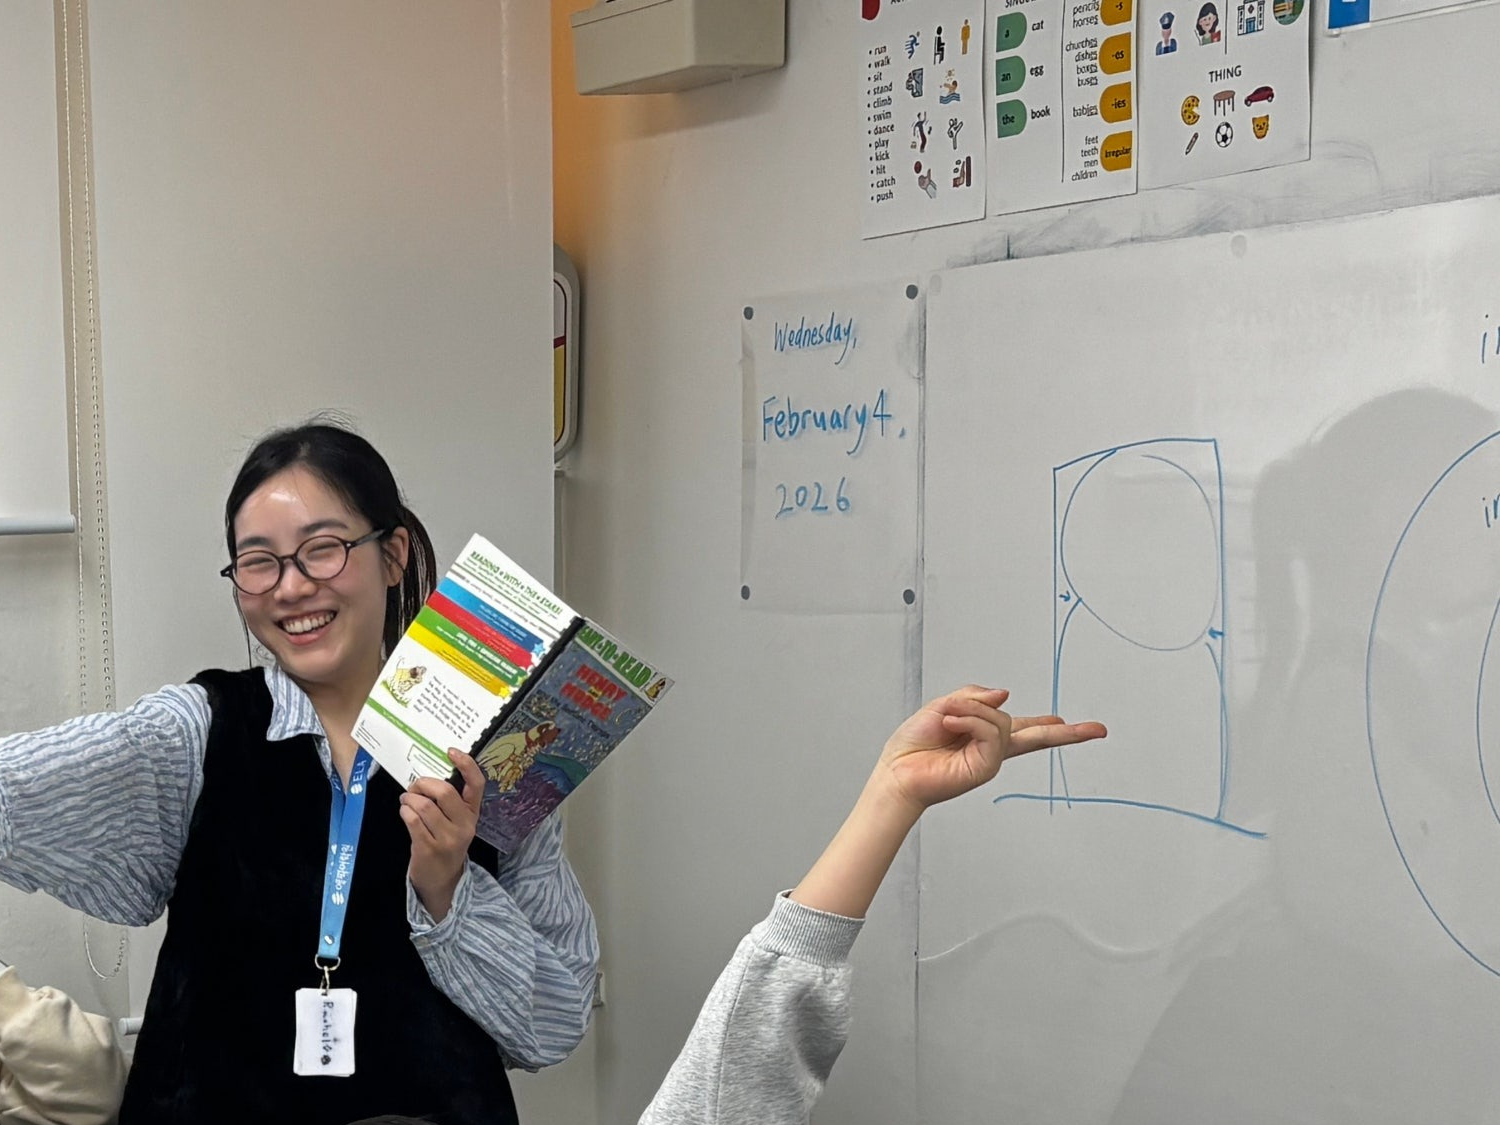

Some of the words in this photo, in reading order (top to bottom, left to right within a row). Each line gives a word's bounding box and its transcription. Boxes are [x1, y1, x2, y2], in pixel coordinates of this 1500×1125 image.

[1073, 1, 1099, 16] pencils
[1032, 20, 1044, 30] cat
[1073, 15, 1098, 27] horses
[1066, 37, 1098, 51] churches
[874, 45, 886, 55] run
[1075, 50, 1098, 61] dishes
[874, 57, 890, 68] walk
[1030, 66, 1043, 77] egg
[1076, 63, 1098, 75] boxes
[1209, 65, 1242, 83] THING
[874, 71, 882, 82] sit
[1077, 77, 1098, 86] buses
[873, 84, 892, 95] stand
[873, 97, 892, 108] climb
[873, 111, 891, 121] swim
[1031, 107, 1050, 119] book
[1073, 104, 1098, 117] babies
[1002, 114, 1015, 124] the
[874, 123, 894, 134] dance
[874, 139, 889, 149] play
[1085, 136, 1098, 145] feet
[875, 150, 889, 161] kick
[1081, 147, 1098, 157] teeth
[1084, 159, 1098, 167] men
[876, 165, 885, 174] hit
[1072, 170, 1097, 181] children
[877, 177, 896, 188] catch
[876, 191, 893, 203] push
[774, 312, 858, 365] Wednesday,
[763, 395, 867, 456] February
[775, 477, 851, 520] 2026
[502, 570, 522, 590] WITH
[608, 650, 655, 689] READ
[353, 759, 366, 781] ELA
